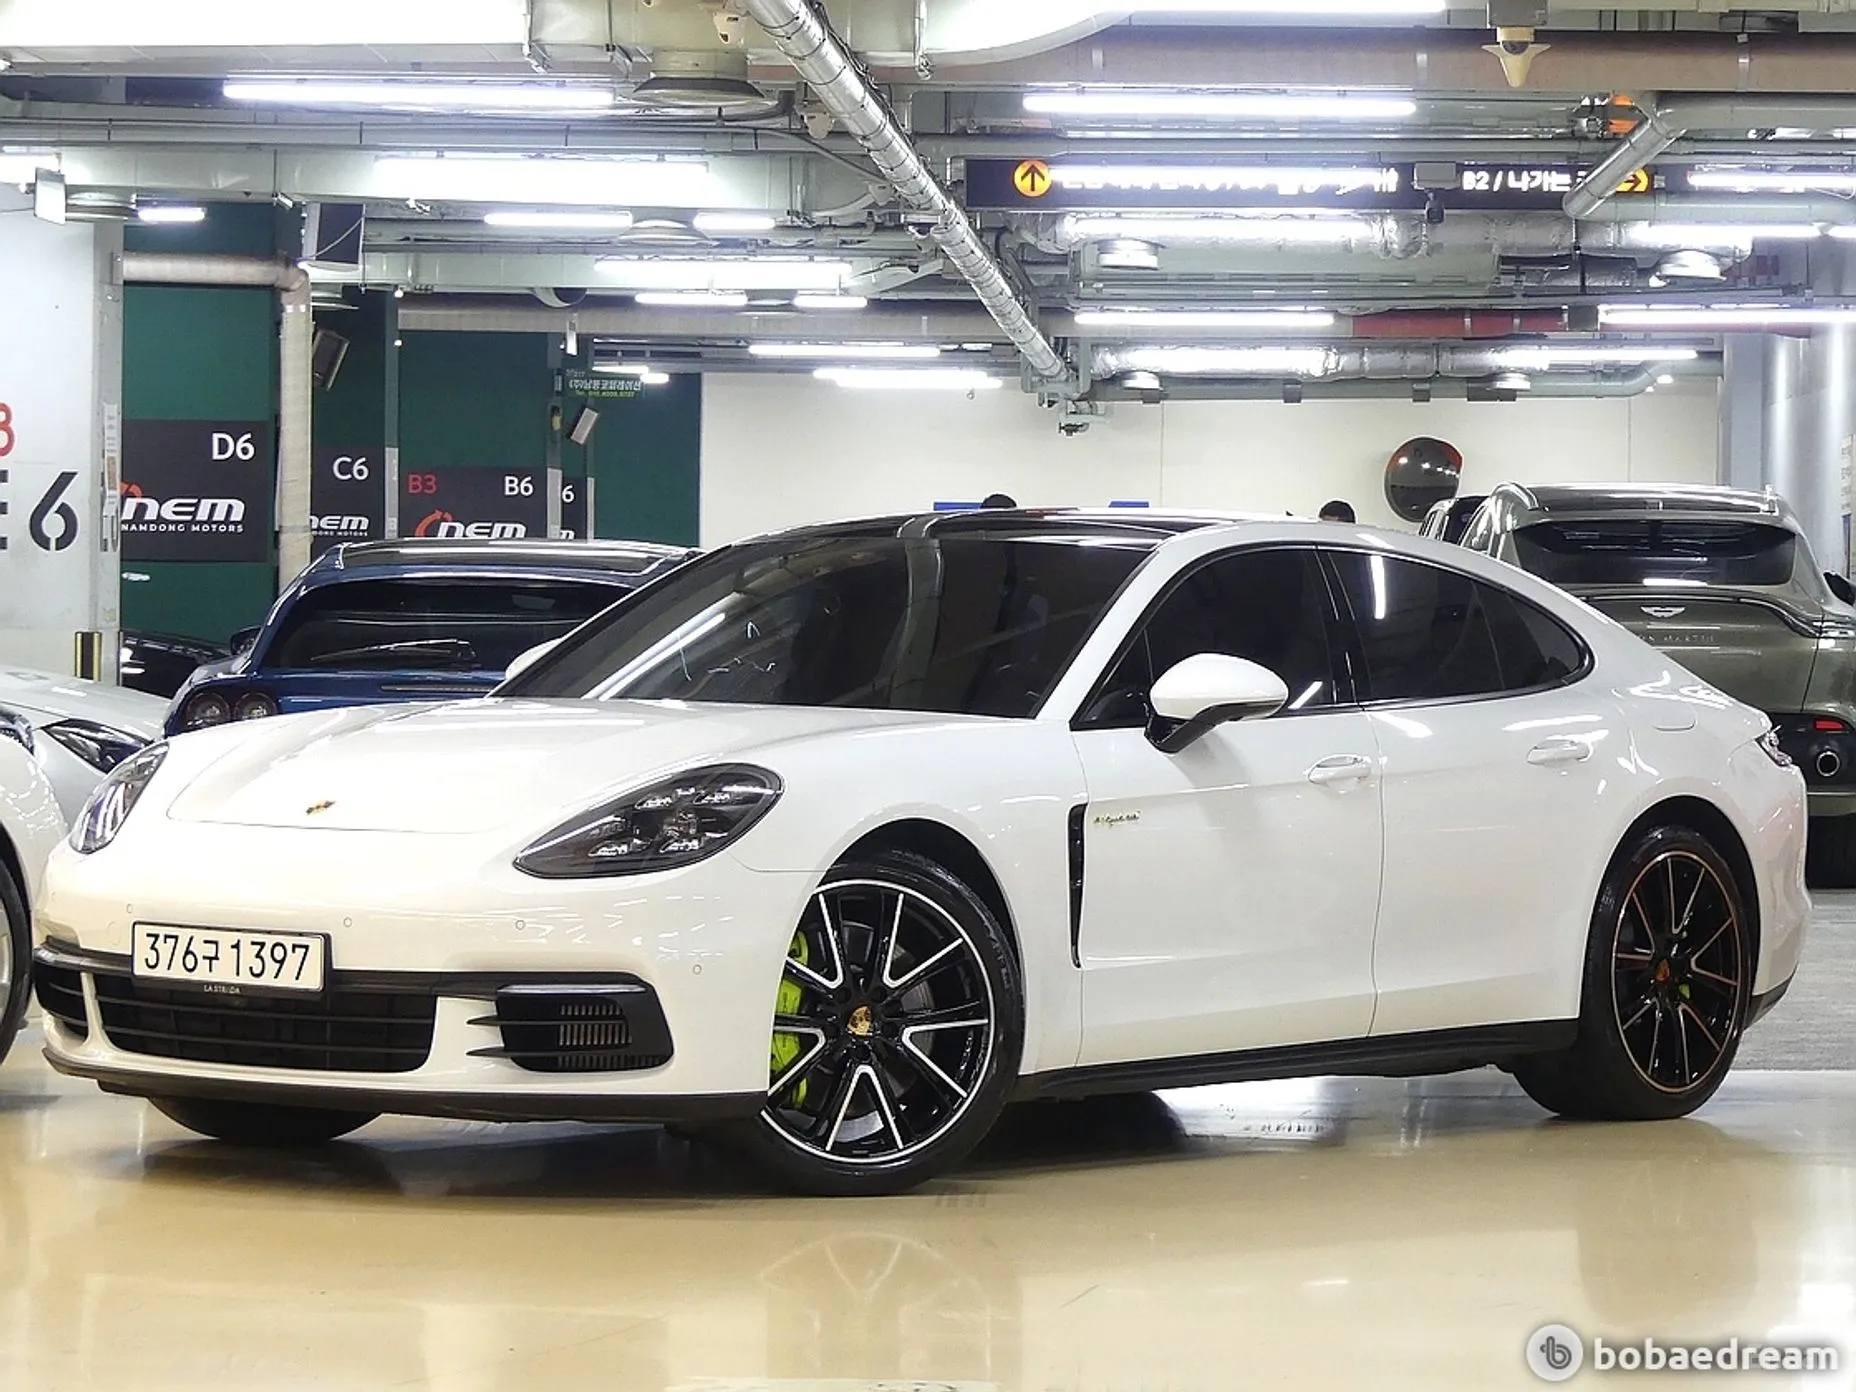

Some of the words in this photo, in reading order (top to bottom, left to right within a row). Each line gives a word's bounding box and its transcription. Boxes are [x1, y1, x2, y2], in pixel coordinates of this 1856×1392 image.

[212, 432, 255, 460] D6
[332, 456, 369, 480] C6
[408, 474, 437, 494] B3
[504, 476, 534, 496] B6
[0, 470, 78, 551] 6
[191, 524, 244, 532] MOTORS
[230, 938, 310, 980] 1397
